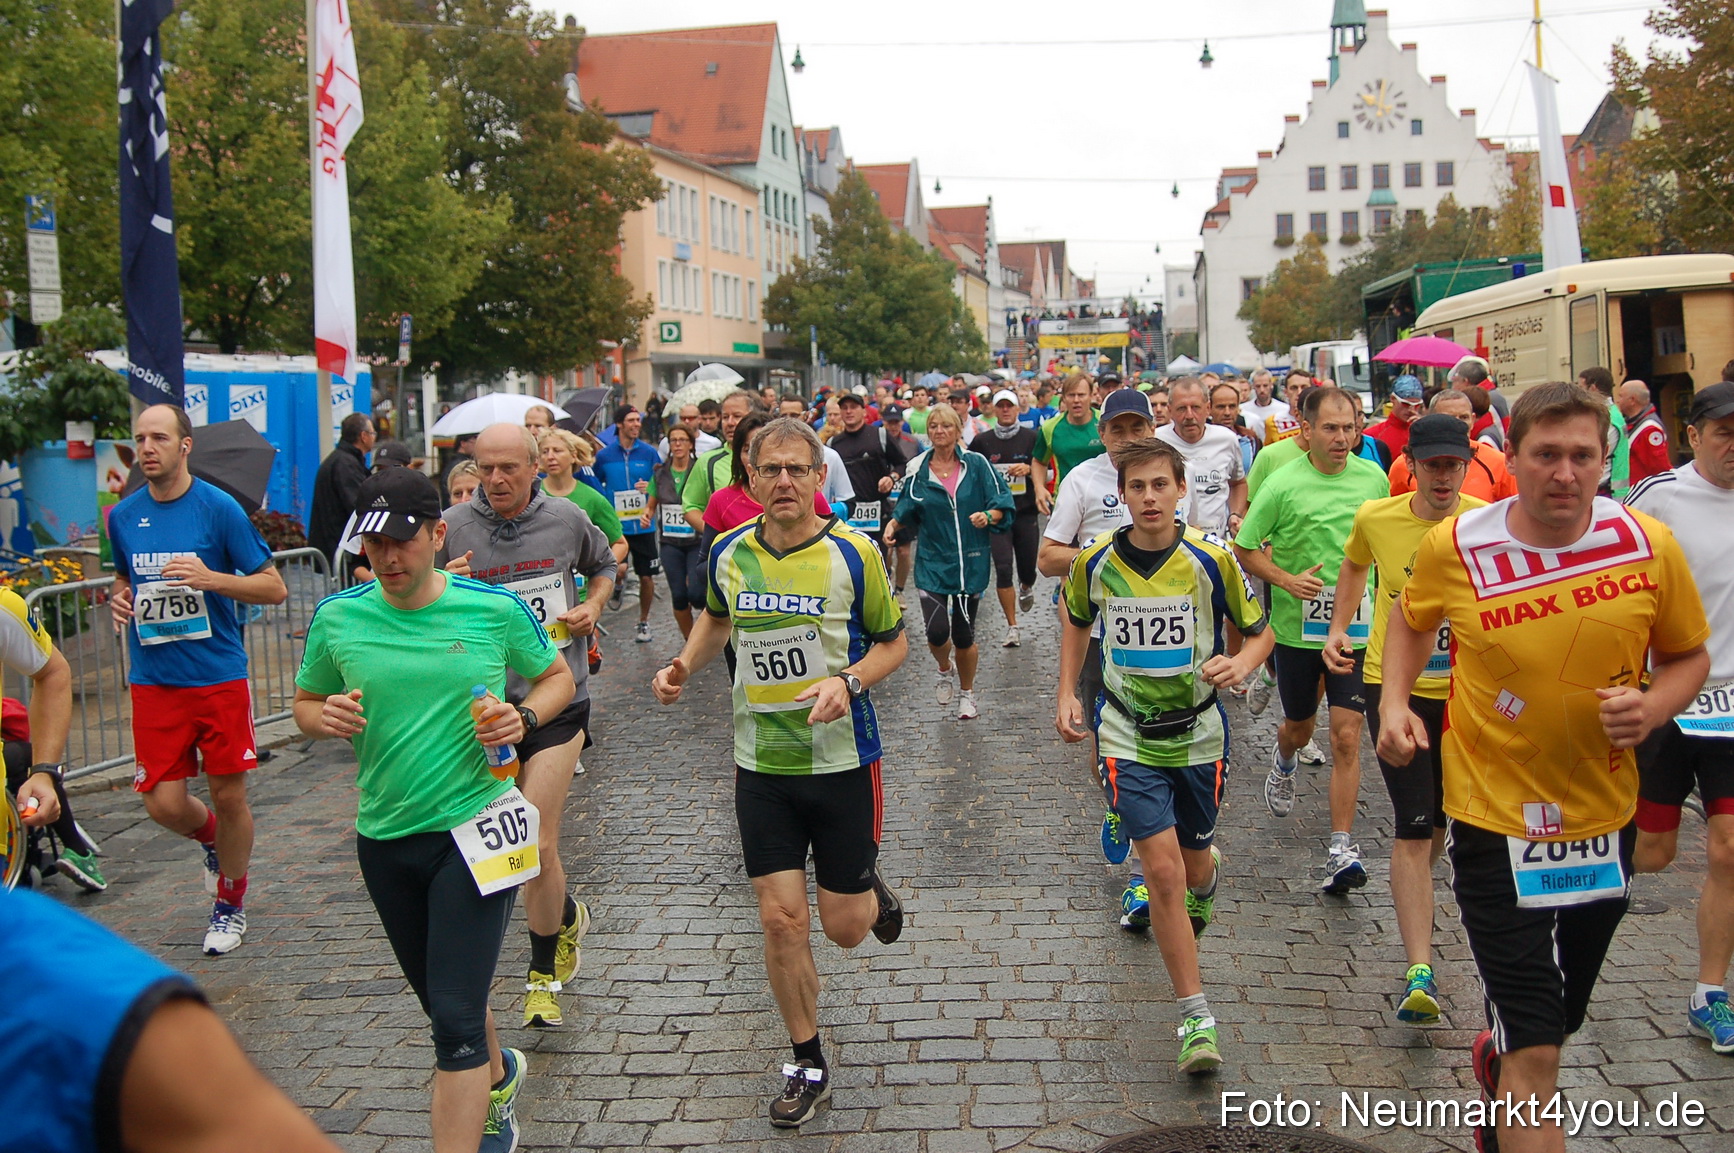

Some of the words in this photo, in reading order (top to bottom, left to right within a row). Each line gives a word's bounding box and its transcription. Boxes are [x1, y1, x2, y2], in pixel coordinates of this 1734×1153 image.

[661, 323, 679, 341] D
[1493, 316, 1543, 343] Bayerisches
[1068, 336, 1099, 345] START
[1493, 346, 1516, 364] Rotes
[622, 496, 641, 509] 146
[140, 594, 199, 621] 2758
[736, 591, 827, 616] BOCK
[1108, 604, 1134, 614] PARTL
[1135, 604, 1177, 614] Neumarkt
[1309, 599, 1361, 621] 251
[1479, 594, 1564, 632] MAX
[1571, 571, 1659, 609] BÖGL
[156, 623, 189, 635] Florian
[1115, 616, 1186, 646] 3125
[760, 634, 803, 649] Neumarkt
[751, 647, 808, 681] 560
[476, 807, 528, 851] 505
[1541, 871, 1596, 890] Richard
